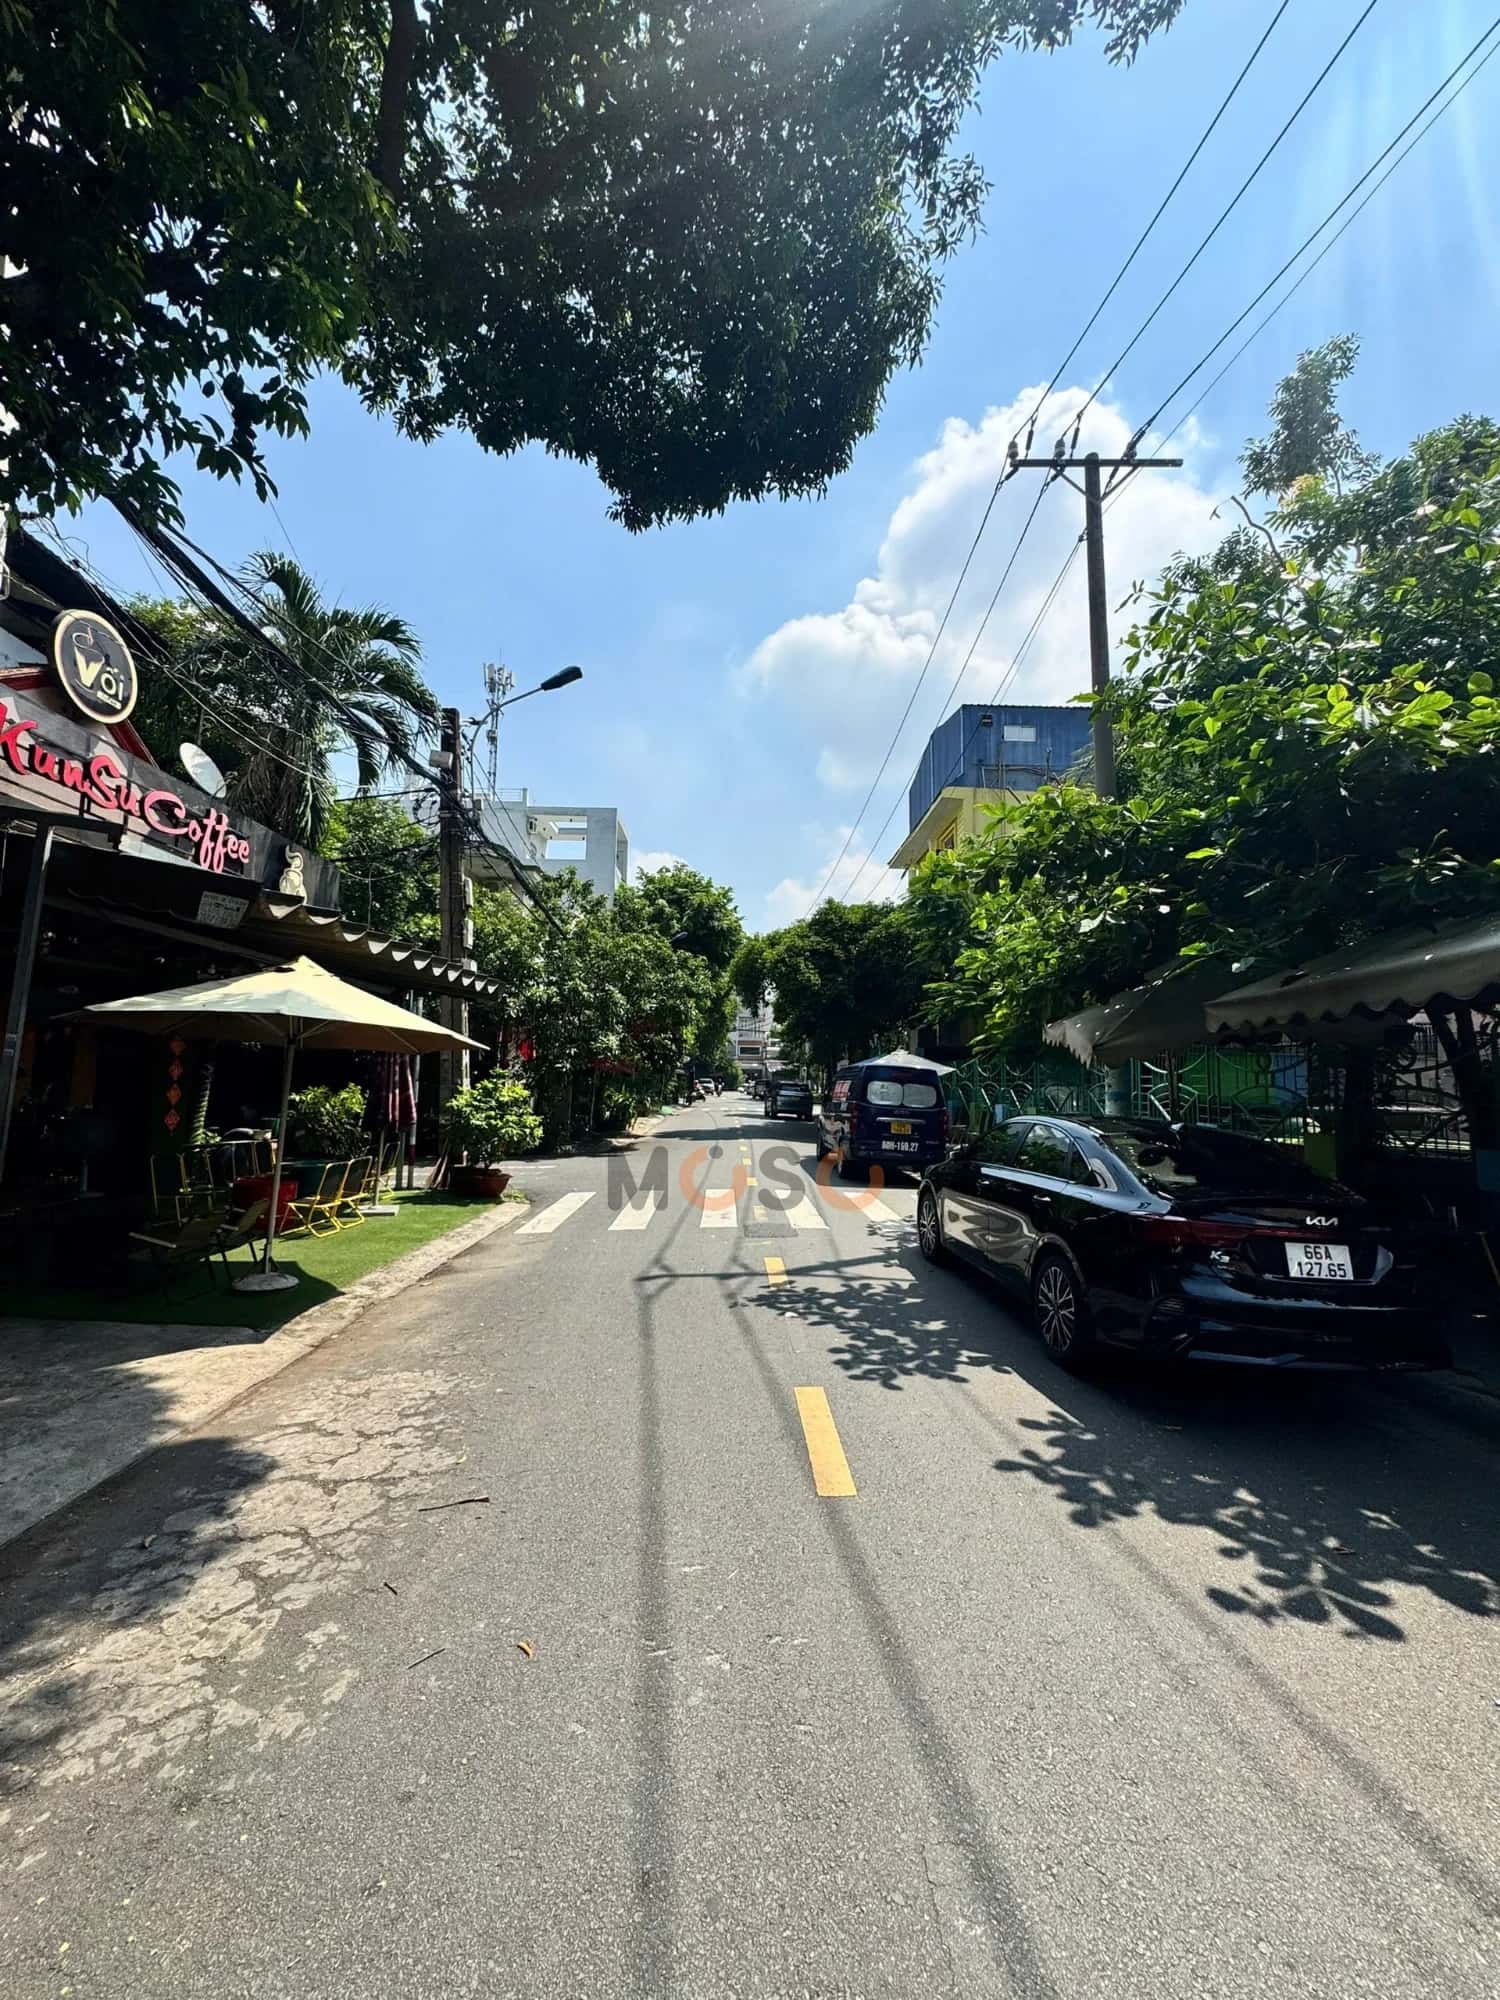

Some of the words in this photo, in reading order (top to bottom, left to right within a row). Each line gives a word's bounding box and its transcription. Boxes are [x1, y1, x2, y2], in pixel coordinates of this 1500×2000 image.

[144, 790, 250, 874] Coffee
[1305, 1215, 1339, 1227] KIA
[1303, 1245, 1333, 1261] 66A
[1297, 1262, 1347, 1278] 127.65
